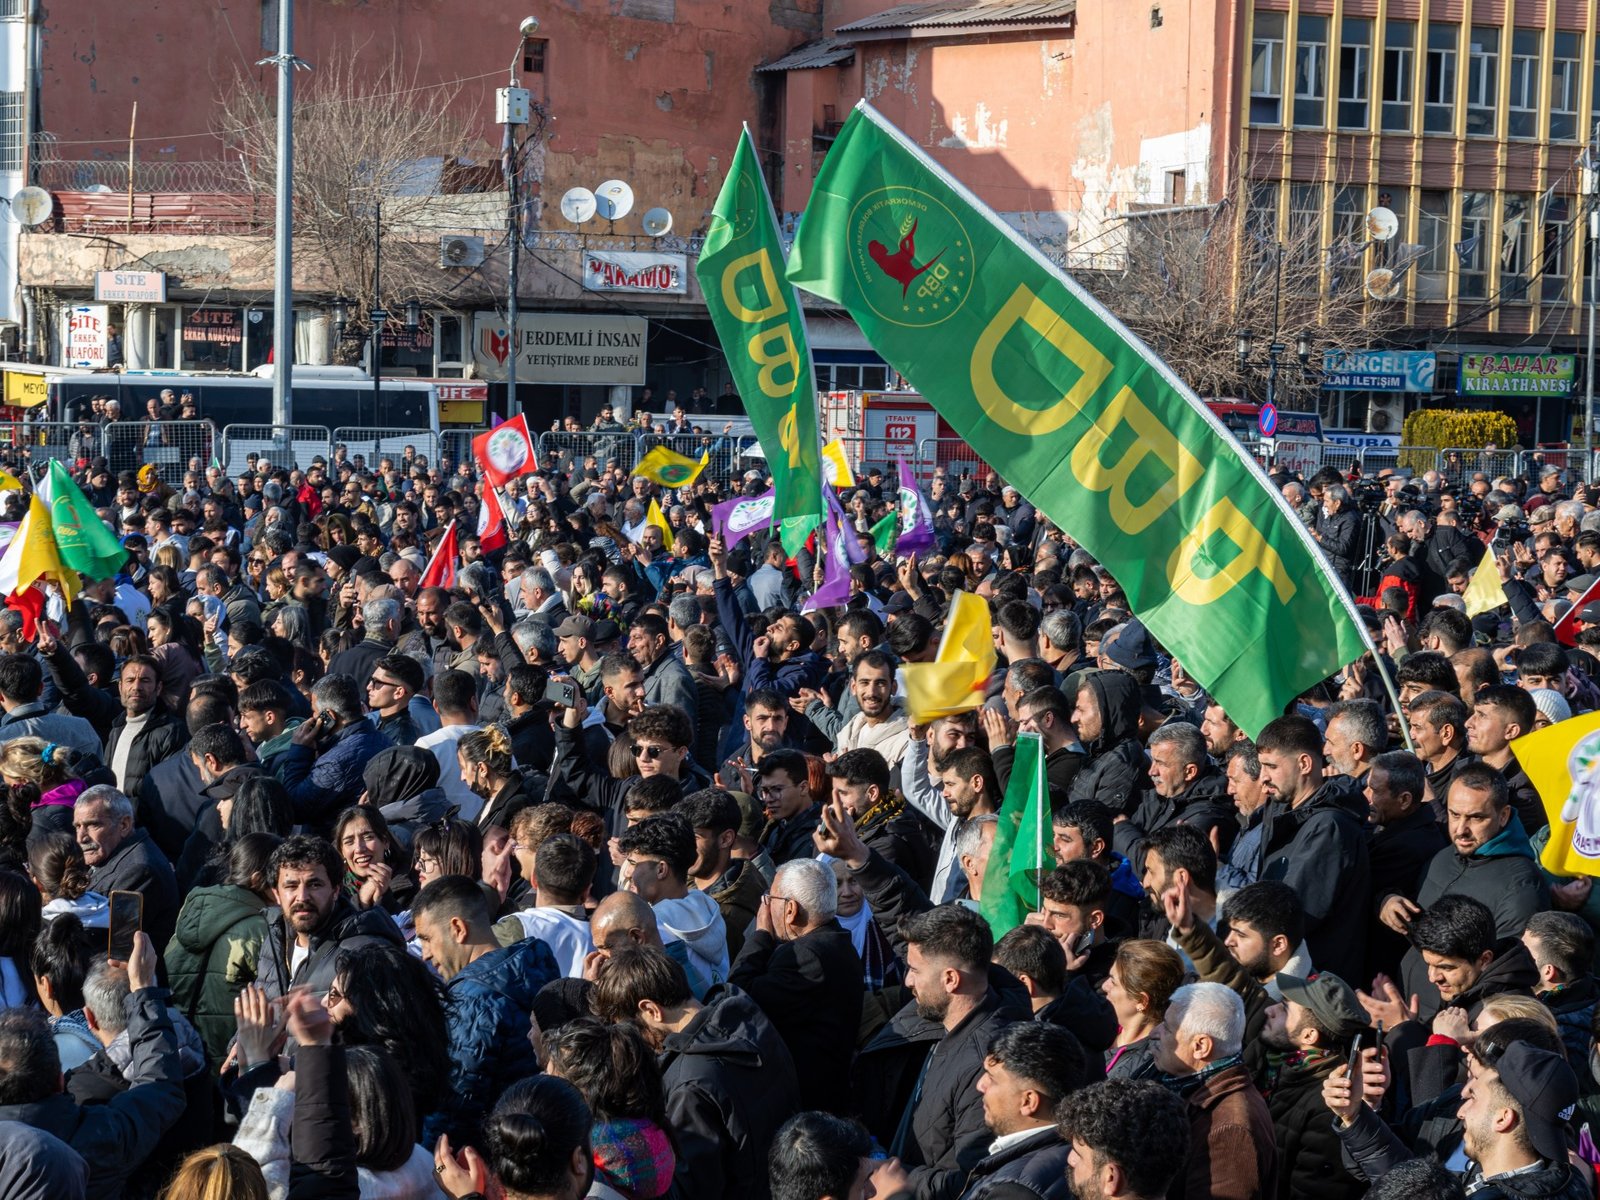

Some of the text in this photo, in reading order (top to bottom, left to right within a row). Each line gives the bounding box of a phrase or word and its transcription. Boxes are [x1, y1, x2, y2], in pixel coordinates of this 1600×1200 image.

[589, 260, 678, 288] YAKAMO
[73, 334, 97, 343] ERKEK
[525, 330, 641, 348] ERDEMLİ İNSAN
[65, 344, 104, 359] KUAFÖRÜ
[526, 353, 639, 368] YETİŞTİRME DERNEĞİ
[1479, 355, 1559, 376] BAHAR
[1324, 376, 1350, 386] LAN
[889, 427, 911, 440] 112
